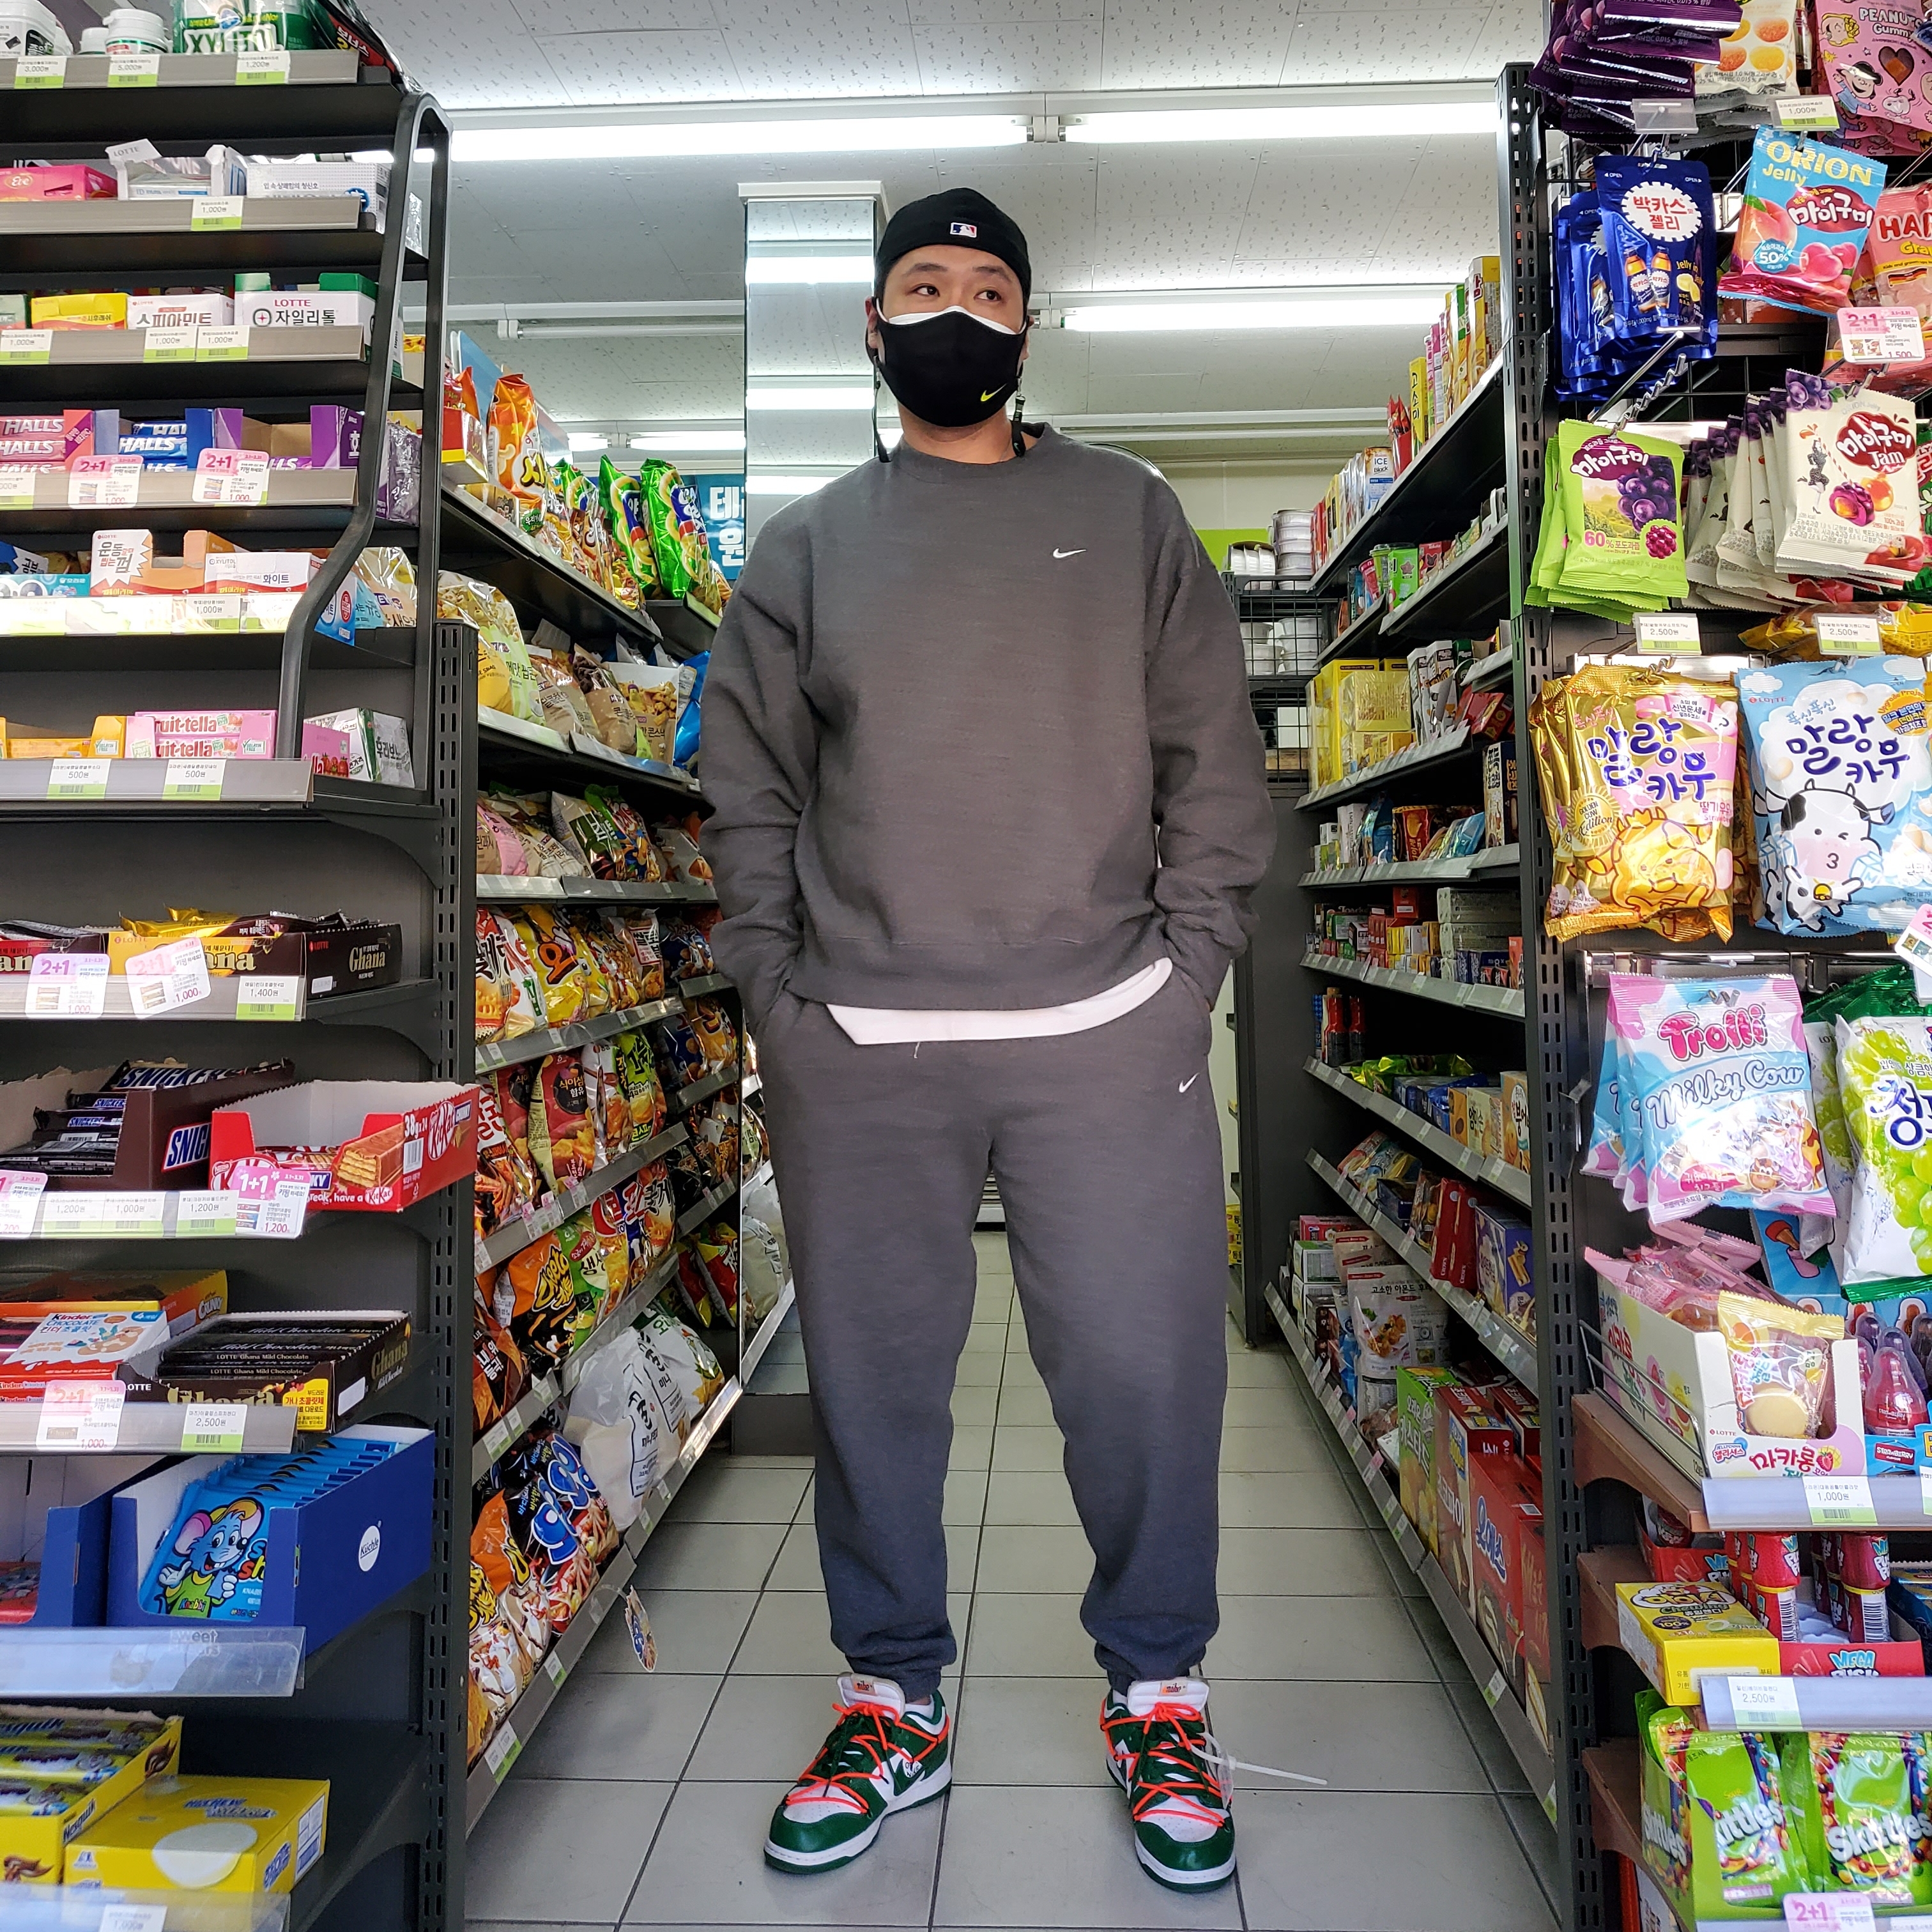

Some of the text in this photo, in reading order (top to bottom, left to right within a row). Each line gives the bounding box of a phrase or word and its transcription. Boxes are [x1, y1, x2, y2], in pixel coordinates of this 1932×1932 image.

[1766, 141, 1872, 187] ORION
[11, 175, 31, 187] Eve
[1762, 163, 1807, 187] Jelly
[1632, 195, 1687, 215] 박카스
[1788, 192, 1873, 227] 마이구미
[1649, 214, 1682, 231] 젤리
[1676, 259, 1692, 270] Jelly
[1759, 251, 1789, 264] 50%
[1632, 277, 1649, 288] 박카스
[136, 312, 212, 327] 스피아민트
[275, 309, 336, 325] 자일리톨
[1848, 313, 1878, 327] 2+1
[1411, 371, 1420, 420] 고소미
[4, 418, 63, 435] HALLS
[119, 437, 175, 452] HALLS
[1837, 417, 1912, 457] 마이구미
[80, 460, 105, 473] 2+1
[205, 455, 233, 469] 2+1
[1373, 457, 1388, 466] ICE
[1571, 445, 1649, 477] 마이구미
[1867, 450, 1906, 469] Jam
[98, 541, 124, 557] 운동
[1614, 541, 1641, 551] 포도과즙
[115, 553, 134, 574] 껌
[263, 574, 290, 584] 화이트
[197, 606, 222, 614] 1,000원
[1786, 714, 1874, 775] 말랑
[1588, 718, 1682, 787] 말랑
[1845, 737, 1910, 783] 카우
[1646, 751, 1716, 801] 카우
[1584, 809, 1598, 820] COW
[313, 940, 329, 951] LOTTE
[136, 953, 164, 976] 2+1
[348, 946, 386, 972] Ghana
[40, 959, 70, 976] 2+1
[175, 987, 199, 1003] 1,000
[250, 988, 279, 997] 1,400원
[68, 1005, 91, 1014] 1,000
[1658, 1003, 1767, 1062] Trolli
[1646, 1059, 1805, 1130] Milky Cow
[239, 1172, 270, 1193] 1+1
[334, 1193, 355, 1202] have
[56, 1204, 86, 1213] 1,200원
[116, 1204, 145, 1213] 1,000원
[190, 1202, 220, 1212] 1,200원
[264, 1222, 288, 1233] 1,200
[1372, 1284, 1416, 1295] 고소한 아몬드
[198, 1295, 224, 1320] CRUNKY
[371, 1340, 408, 1380] Ghana
[54, 1389, 85, 1403] 2+1
[286, 1397, 325, 1406] 가나 초콜릿체
[195, 1418, 226, 1427] 2,500원
[81, 1439, 105, 1448] 1,000
[1714, 1448, 1745, 1462] 젤리셔스
[1749, 1446, 1816, 1473] 마카롱
[1876, 1445, 1913, 1460] STRAWBERRY
[1817, 1492, 1850, 1501] 1,000원
[178, 1596, 206, 1612] Knabbi
[1644, 1590, 1724, 1604] 아이셔
[1660, 1602, 1729, 1614] Chewing
[1683, 1608, 1723, 1616] 츄잉캔디
[1828, 1650, 1876, 1671] MEGA
[1742, 1693, 1775, 1703] 2,500원
[1827, 1813, 1932, 1863] Skittles
[1794, 1901, 1829, 1922] 2+1
